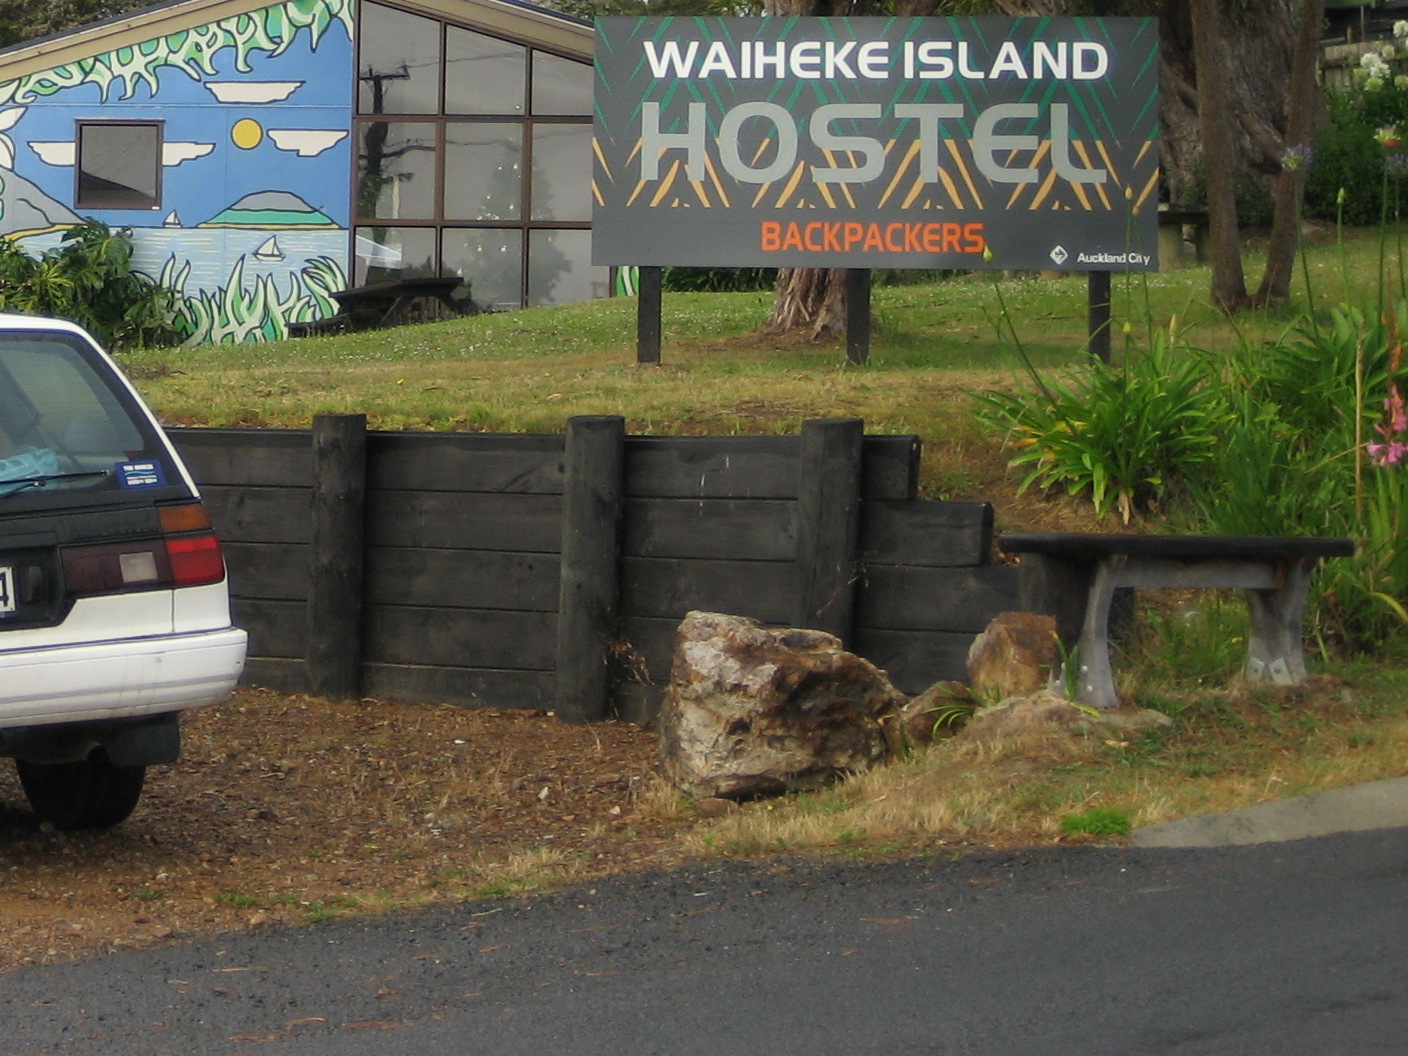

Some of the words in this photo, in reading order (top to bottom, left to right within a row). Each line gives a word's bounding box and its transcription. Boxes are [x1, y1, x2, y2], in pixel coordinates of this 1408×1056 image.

[643, 41, 889, 79] WAIHEKE
[903, 41, 1109, 80] ISLAND
[641, 101, 1108, 184] HOSTEL
[760, 220, 985, 253] BACKPACKERS
[1076, 252, 1127, 264] Auckland
